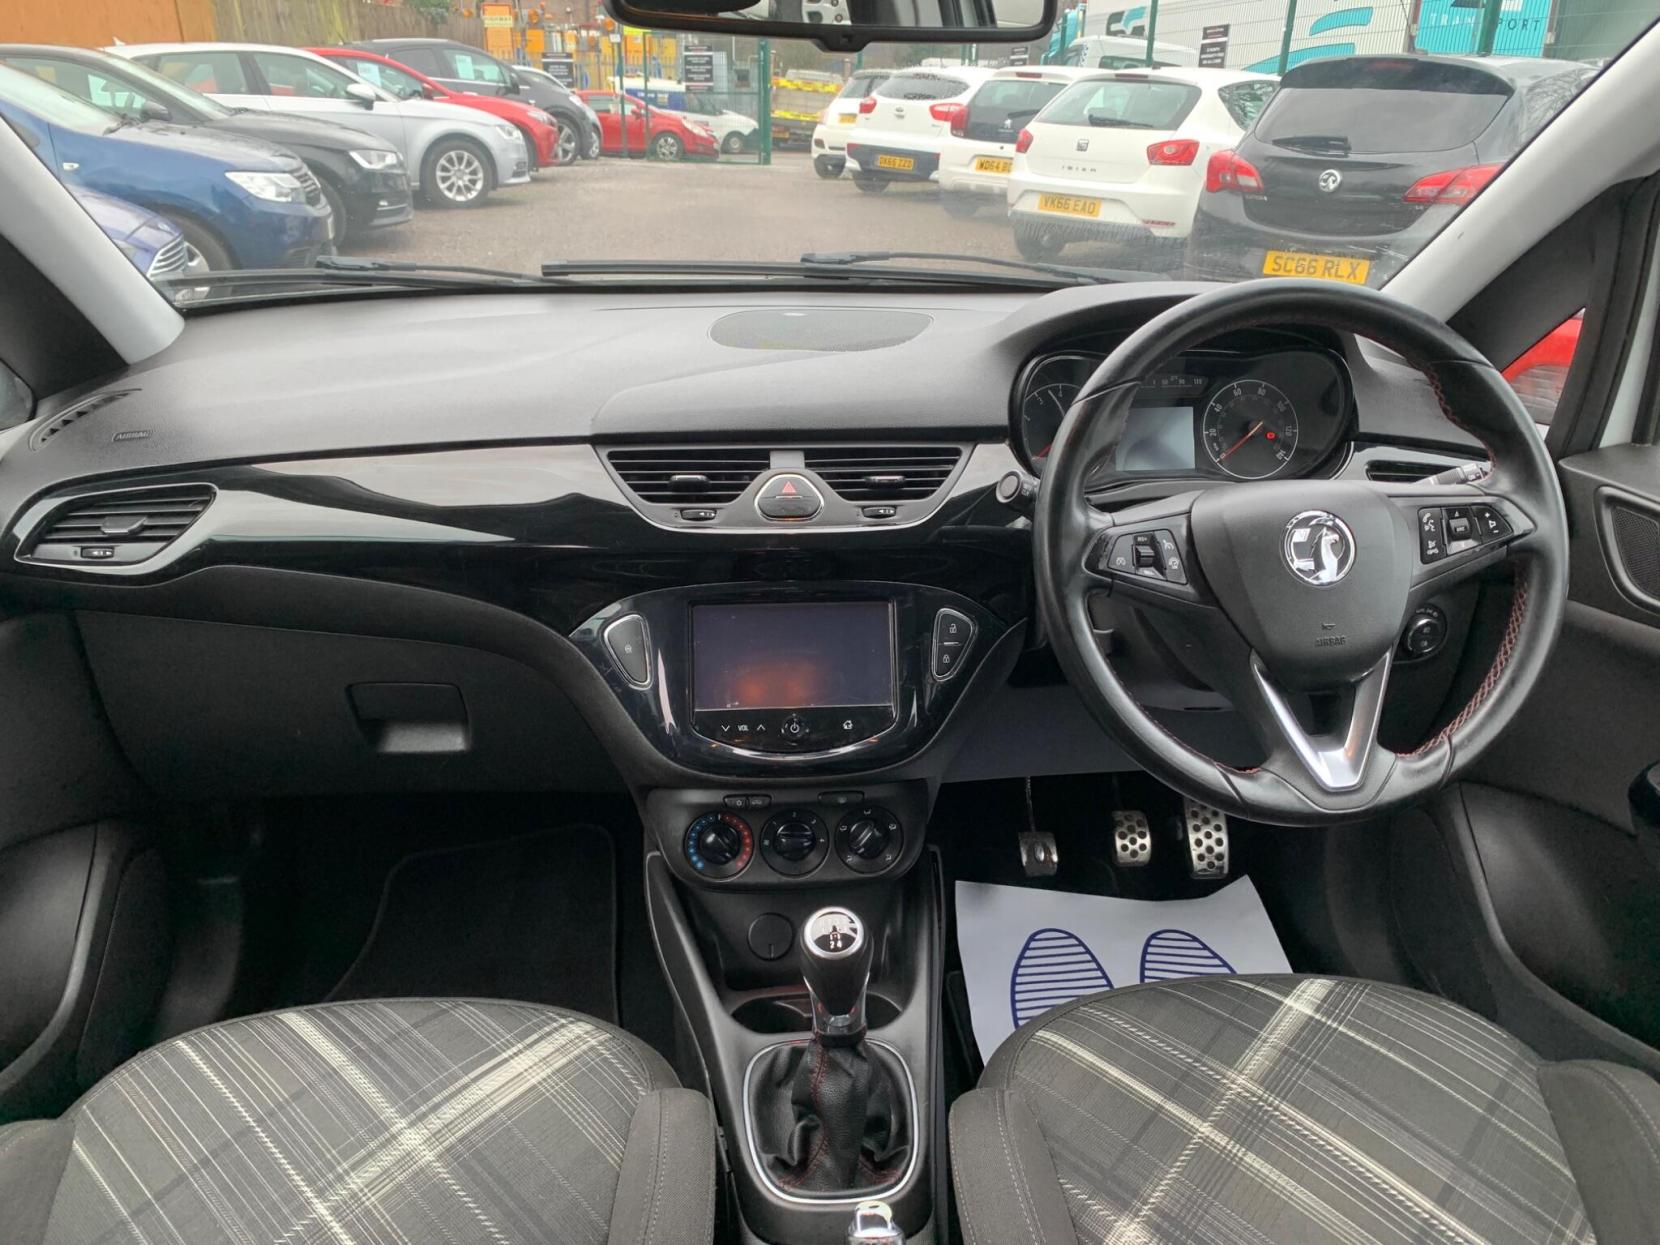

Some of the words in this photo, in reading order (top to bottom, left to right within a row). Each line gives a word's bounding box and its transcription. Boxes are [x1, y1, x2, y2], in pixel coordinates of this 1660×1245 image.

[1430, 13, 1540, 32] TRANPORT
[1043, 194, 1071, 210] VK66
[1271, 255, 1318, 275] SC66
[1322, 259, 1361, 281] RLX
[737, 724, 749, 732] VOL
